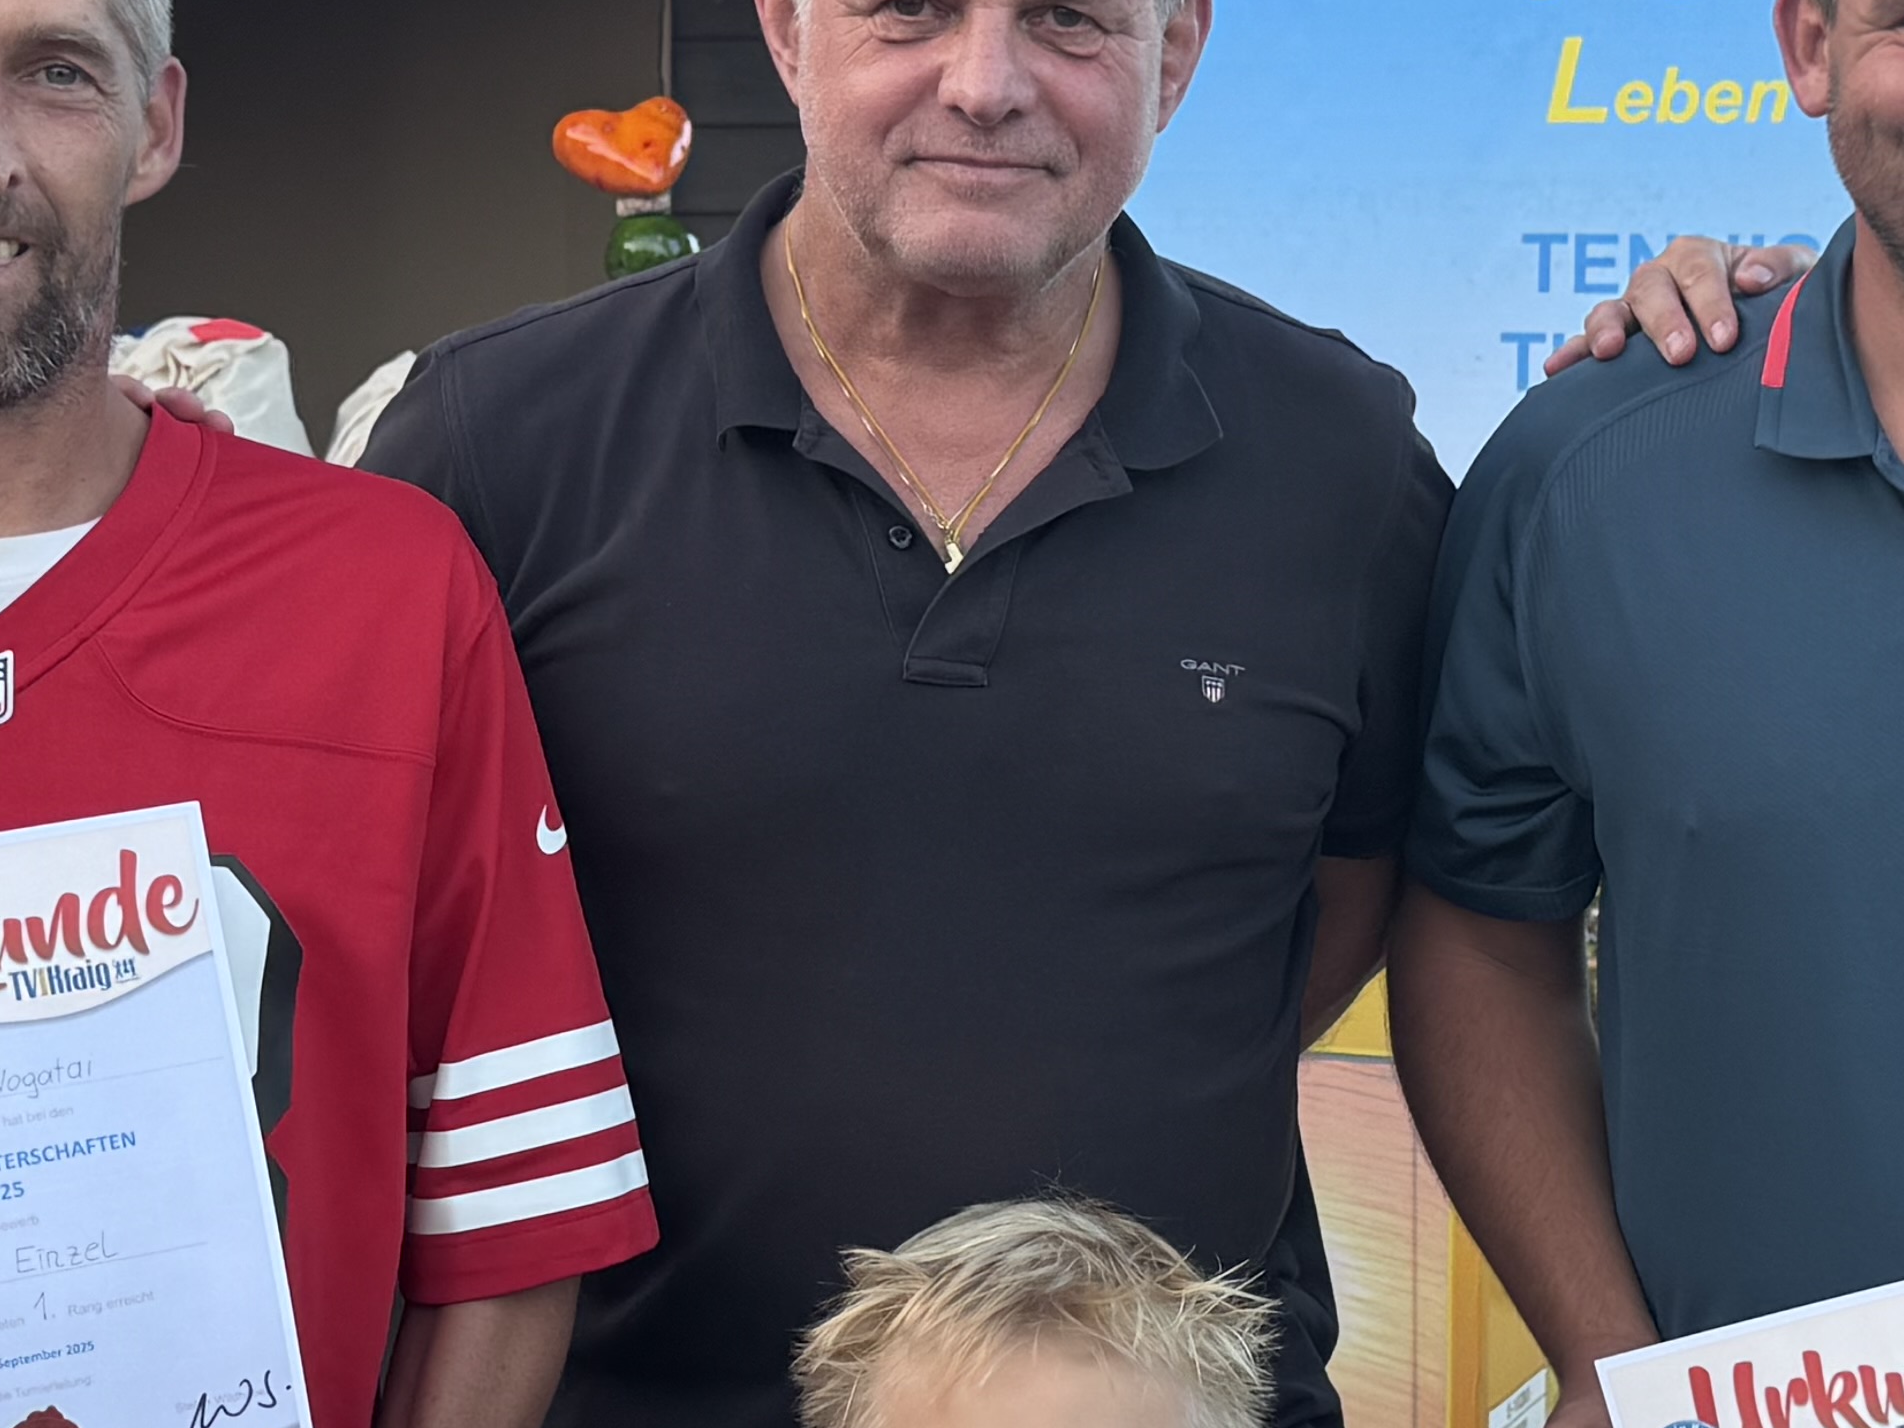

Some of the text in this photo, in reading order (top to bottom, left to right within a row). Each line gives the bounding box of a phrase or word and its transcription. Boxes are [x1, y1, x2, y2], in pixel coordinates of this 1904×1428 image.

[1548, 36, 1790, 124] Leben
[1180, 659, 1246, 676] GANT
[15, 1231, 120, 1275] Einzel
